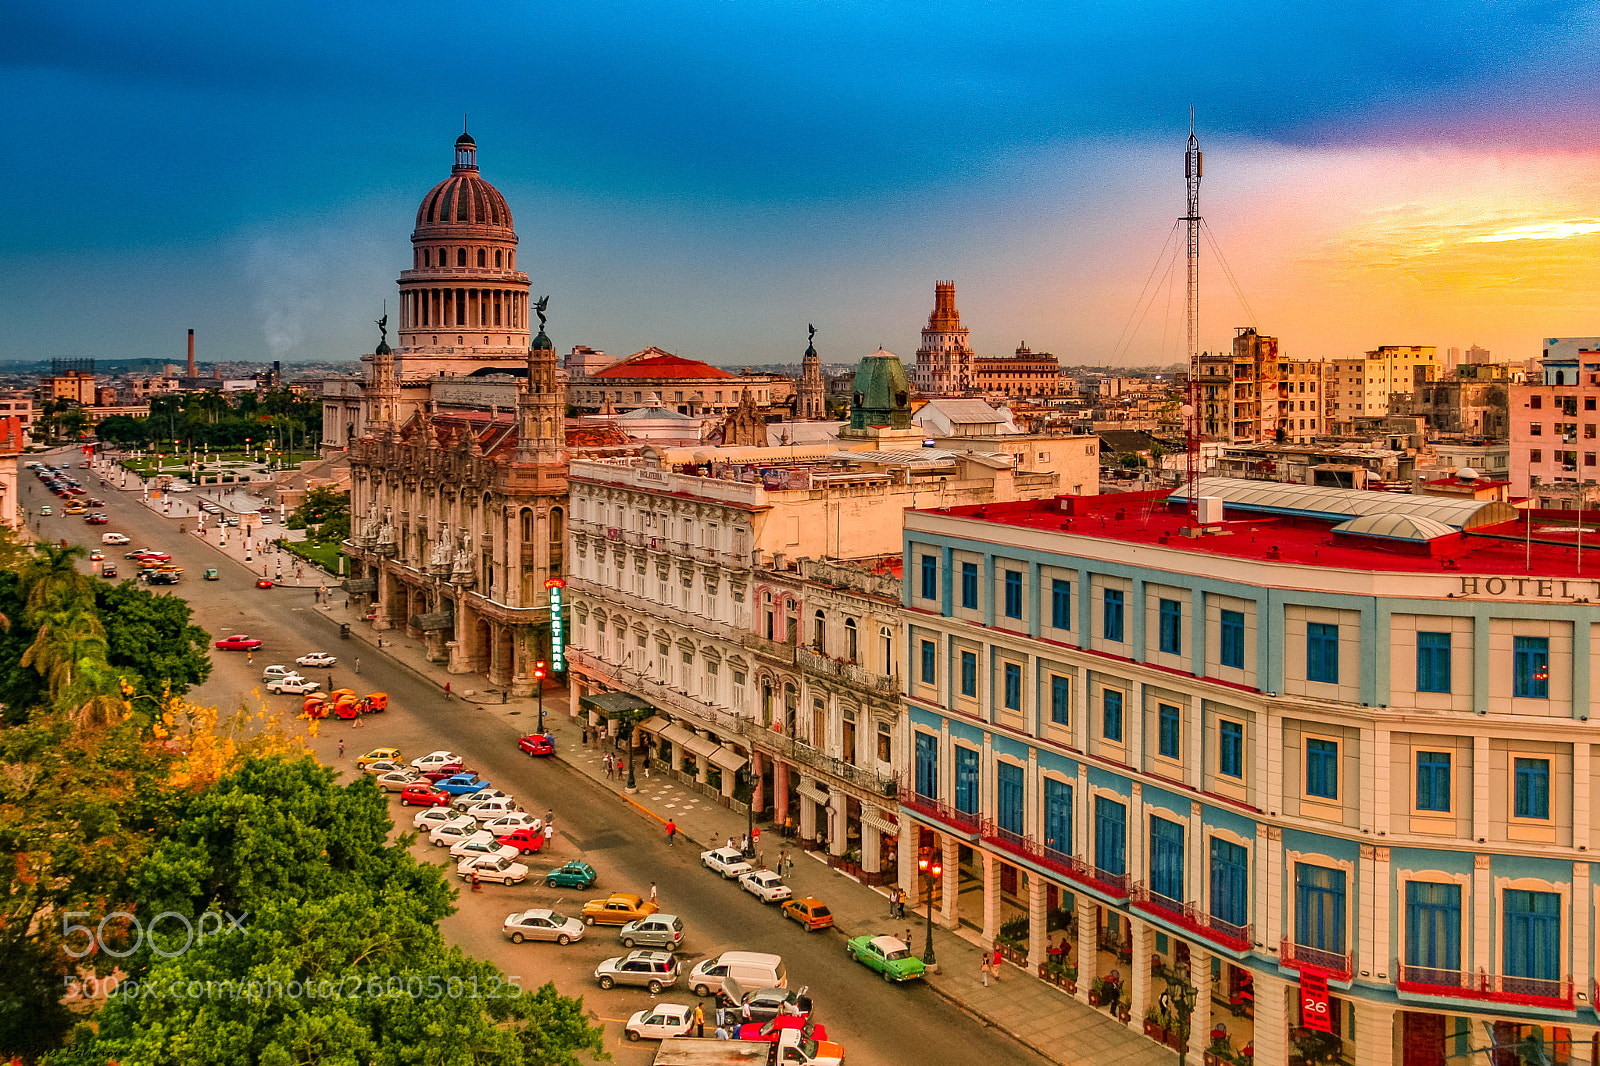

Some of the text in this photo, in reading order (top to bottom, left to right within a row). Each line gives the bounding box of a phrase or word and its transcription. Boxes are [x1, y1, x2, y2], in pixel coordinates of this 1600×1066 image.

[546, 580, 563, 588] HOTEL
[1460, 576, 1574, 599] HOTEL
[551, 587, 562, 670] INGLATERRA
[1304, 998, 1327, 1013] 26
